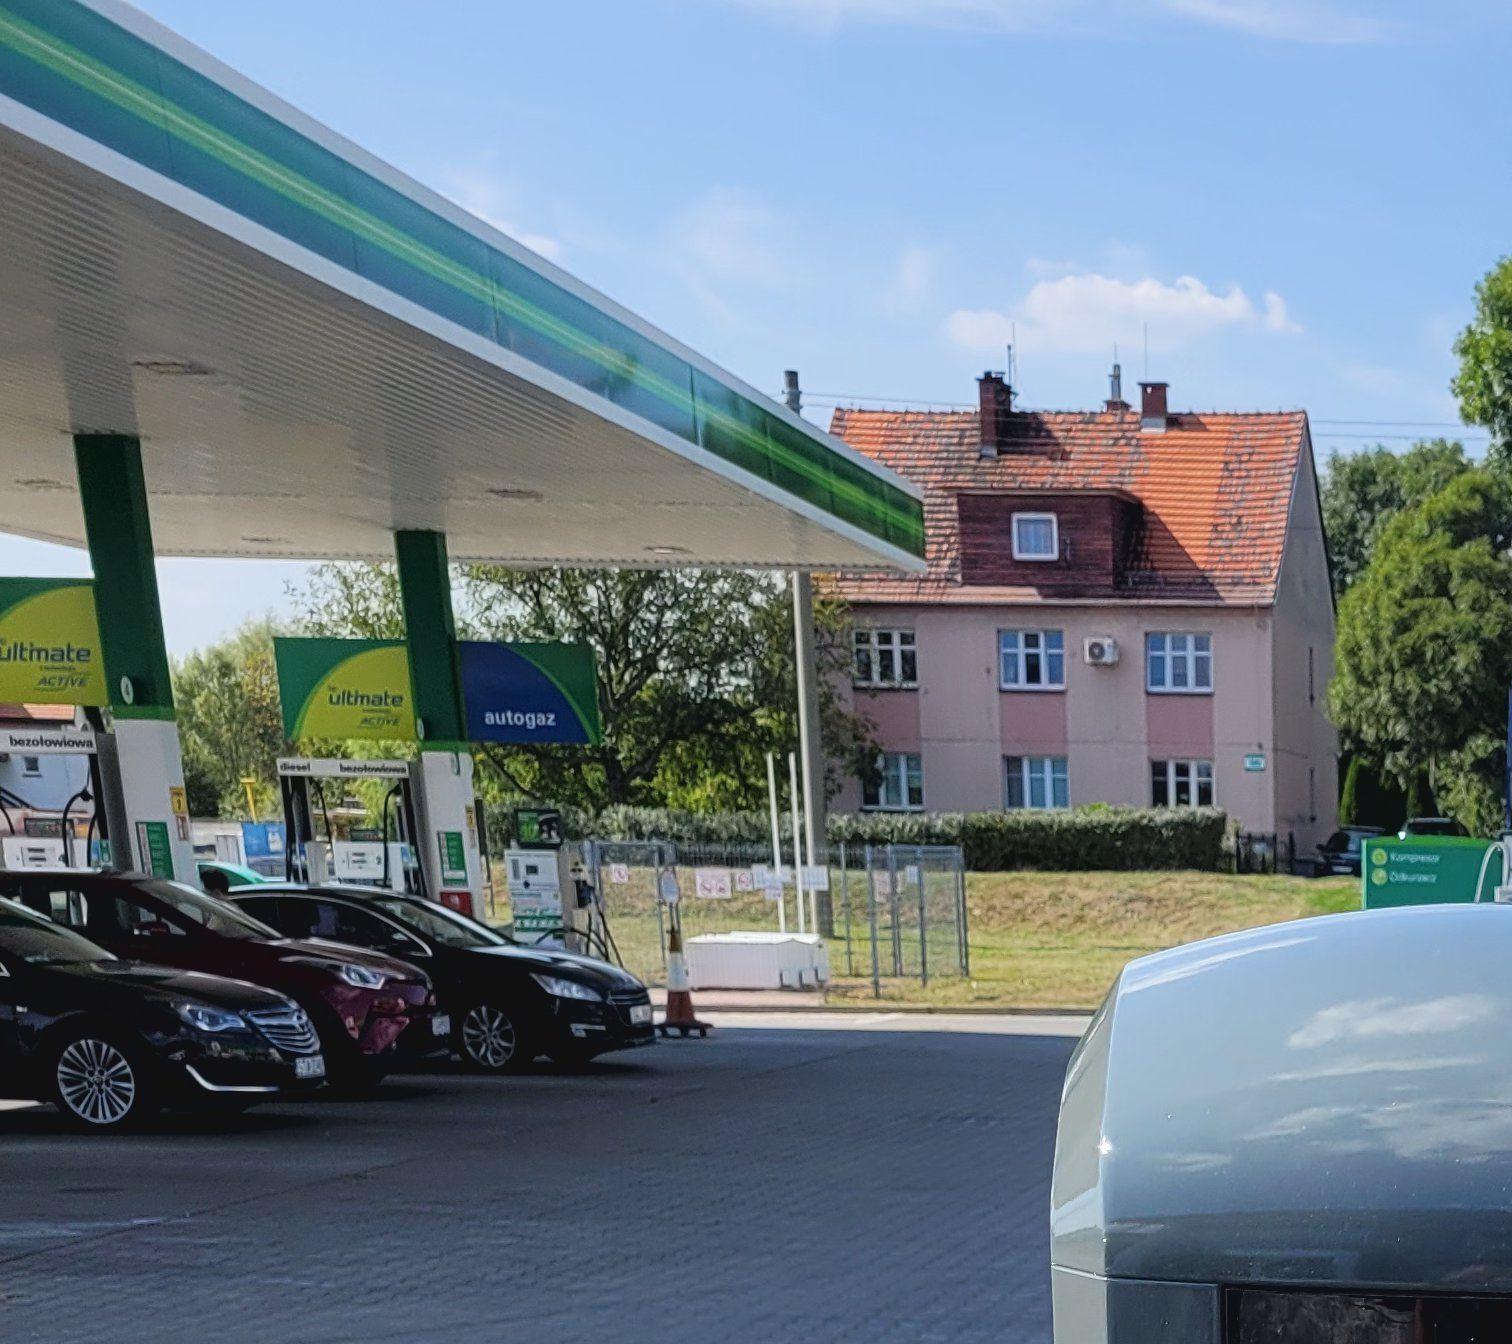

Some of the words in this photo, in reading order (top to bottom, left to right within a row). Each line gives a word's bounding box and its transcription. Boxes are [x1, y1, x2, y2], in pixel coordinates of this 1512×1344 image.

[0, 642, 91, 663] ultimate
[37, 675, 88, 688] ACTIVE
[328, 688, 403, 707] ultimate
[484, 710, 556, 729] autogaz
[280, 763, 310, 772] diesel
